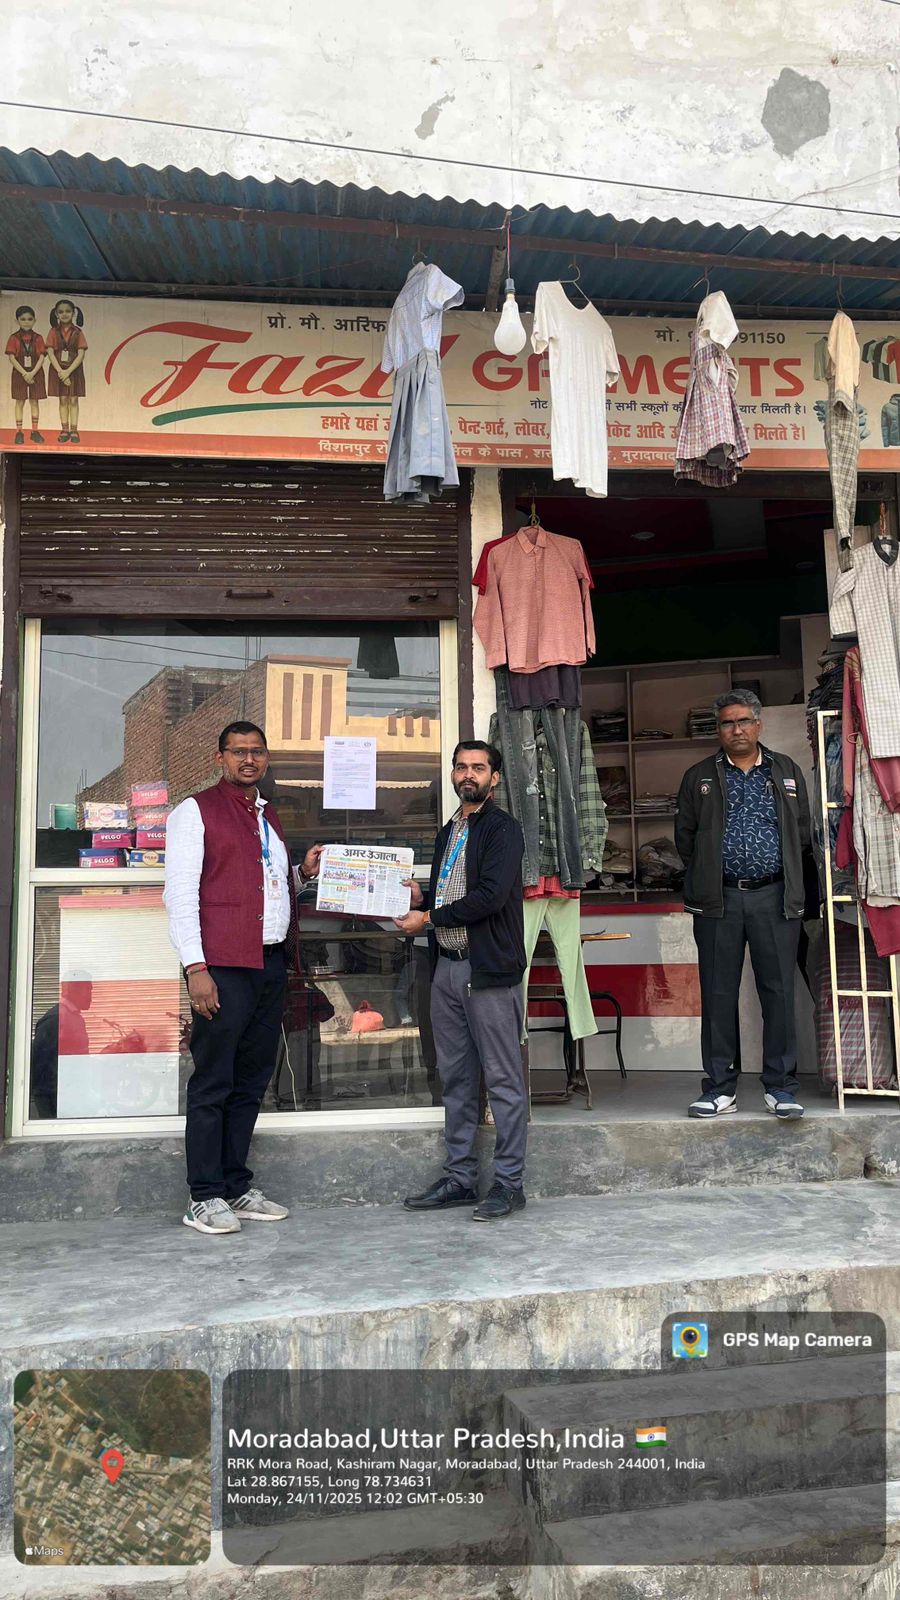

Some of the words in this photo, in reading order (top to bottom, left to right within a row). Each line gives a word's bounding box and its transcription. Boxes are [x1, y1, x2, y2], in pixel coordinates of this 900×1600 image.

[687, 331, 786, 344] 91150
[104, 320, 459, 408] Fazi
[472, 350, 805, 398] GMETS
[614, 400, 638, 412] सभी
[761, 402, 791, 414] मिलती
[321, 412, 351, 431] हमारे
[636, 420, 666, 439] आदि
[753, 423, 788, 441] मिलते
[375, 440, 389, 454] रो
[477, 444, 492, 457] के
[343, 848, 367, 858] अमर
